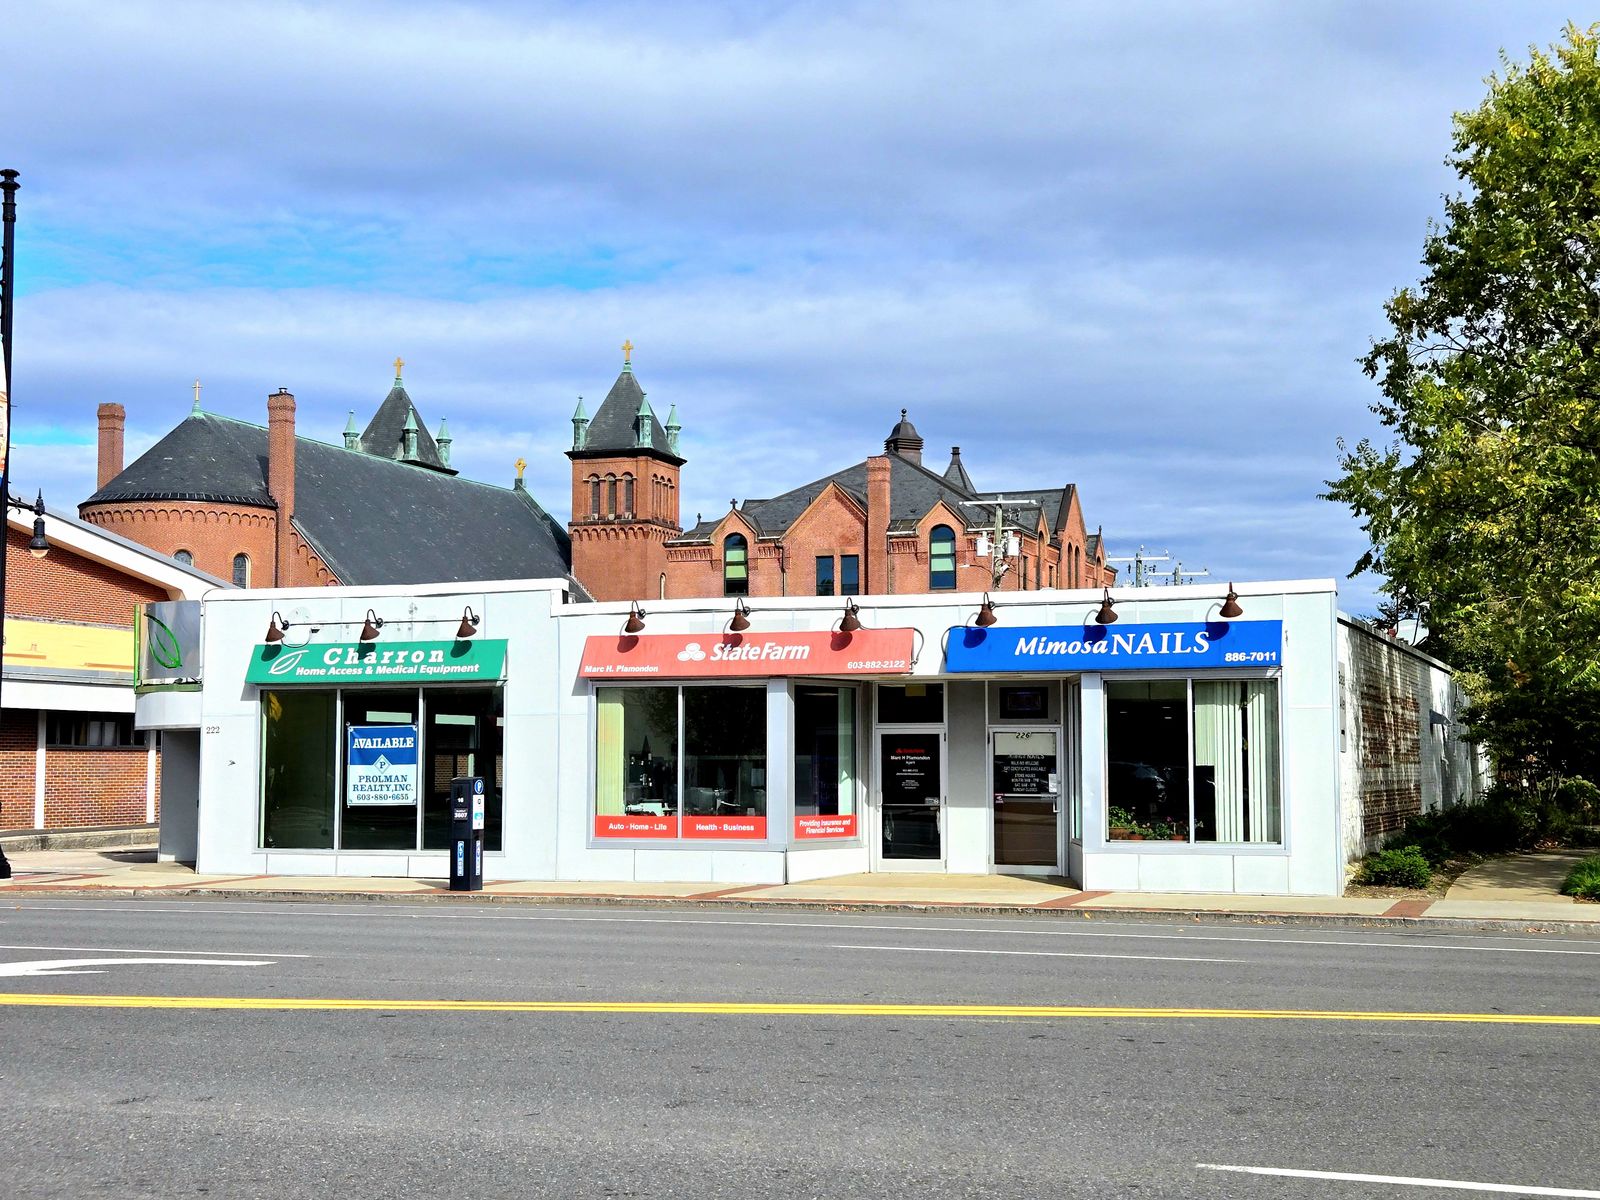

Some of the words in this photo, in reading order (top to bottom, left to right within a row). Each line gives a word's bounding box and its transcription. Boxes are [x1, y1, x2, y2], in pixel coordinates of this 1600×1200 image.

[1014, 636, 1108, 655] Mimosa
[1111, 631, 1210, 655] NAILS
[323, 647, 444, 665] Charron
[1225, 652, 1277, 662] 886-7011
[296, 667, 326, 676] Home
[327, 667, 363, 675] Access
[365, 666, 373, 675] &
[376, 665, 417, 674] Medical
[419, 663, 480, 675] Equipment
[584, 664, 605, 673] Marc
[606, 664, 614, 673] H.
[616, 663, 659, 673] Plamondon
[847, 660, 906, 669] 603-882-2122
[206, 725, 220, 735] 222
[352, 737, 414, 749] AVAILABLE
[380, 761, 386, 769] P
[358, 775, 408, 783] PROLMAN
[696, 823, 718, 831] Health
[723, 823, 755, 831] Business
